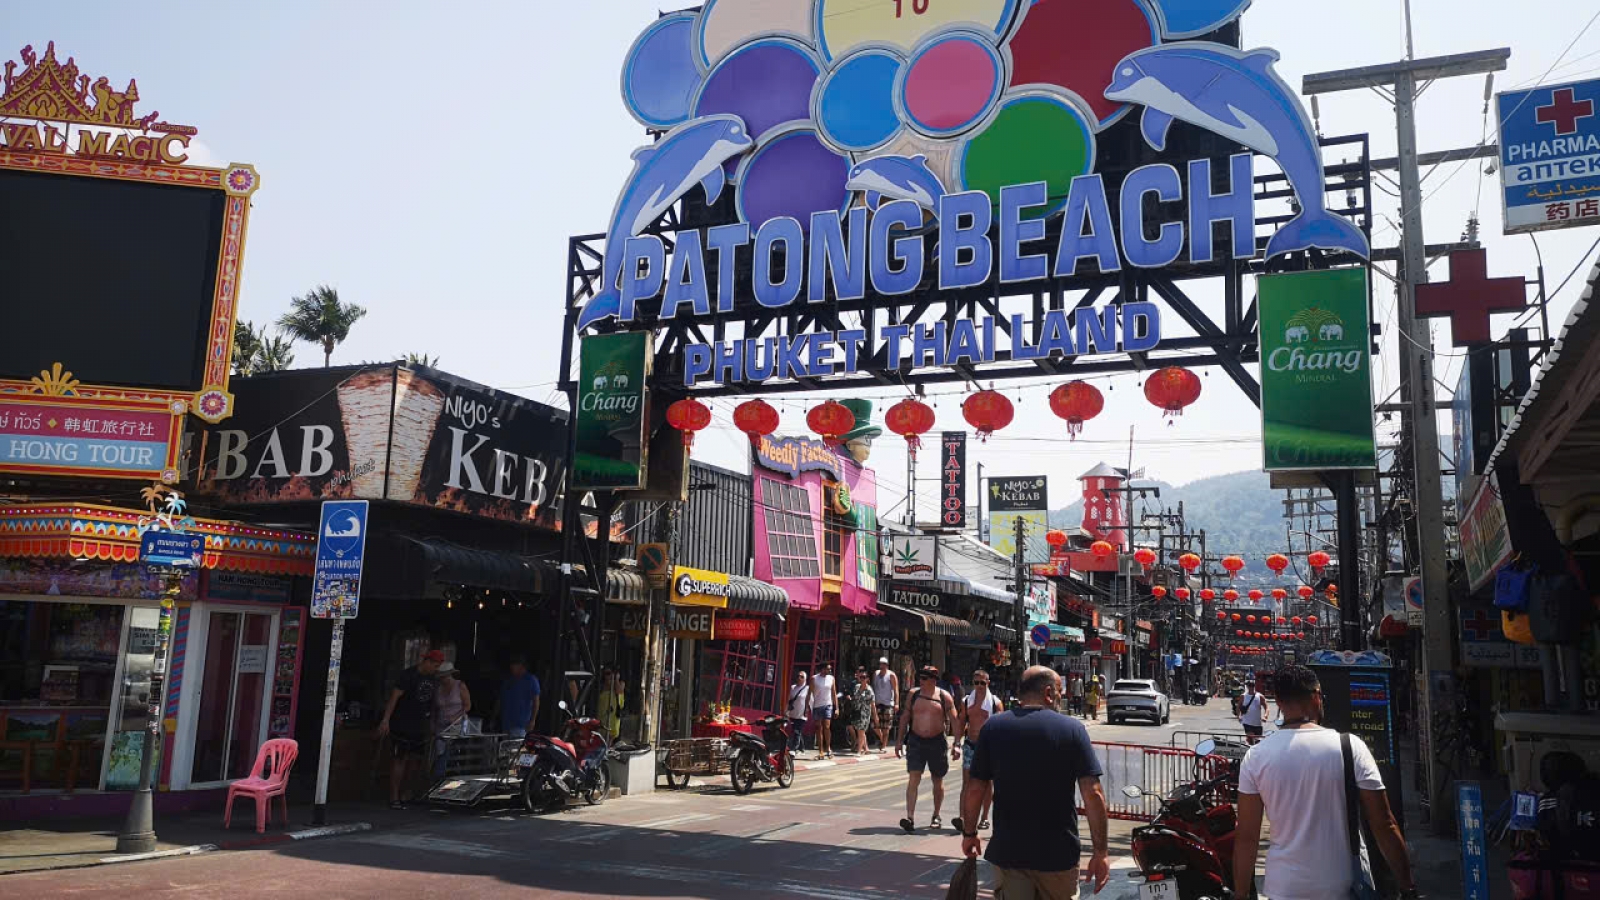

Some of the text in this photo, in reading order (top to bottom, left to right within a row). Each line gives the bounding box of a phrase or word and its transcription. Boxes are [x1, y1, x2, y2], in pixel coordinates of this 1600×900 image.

[75, 130, 191, 164] MAGIC
[1508, 134, 1600, 162] PHARMA
[1545, 199, 1599, 221] 药店
[616, 153, 1256, 322] PATONG BEACH
[683, 328, 866, 386] PHUKET
[1268, 346, 1362, 374] Chang
[581, 392, 639, 414] Chang
[14, 411, 42, 430] ทัวร์
[64, 417, 155, 436] 韩虹旅行社
[8, 439, 153, 466] HONG TOUR
[944, 441, 962, 524] TATTOO
[1002, 492, 1041, 501] KEBAB
[692, 580, 731, 597] SUPERRICH
[892, 590, 940, 607] TATTOO
[854, 635, 901, 650] TATTOO
